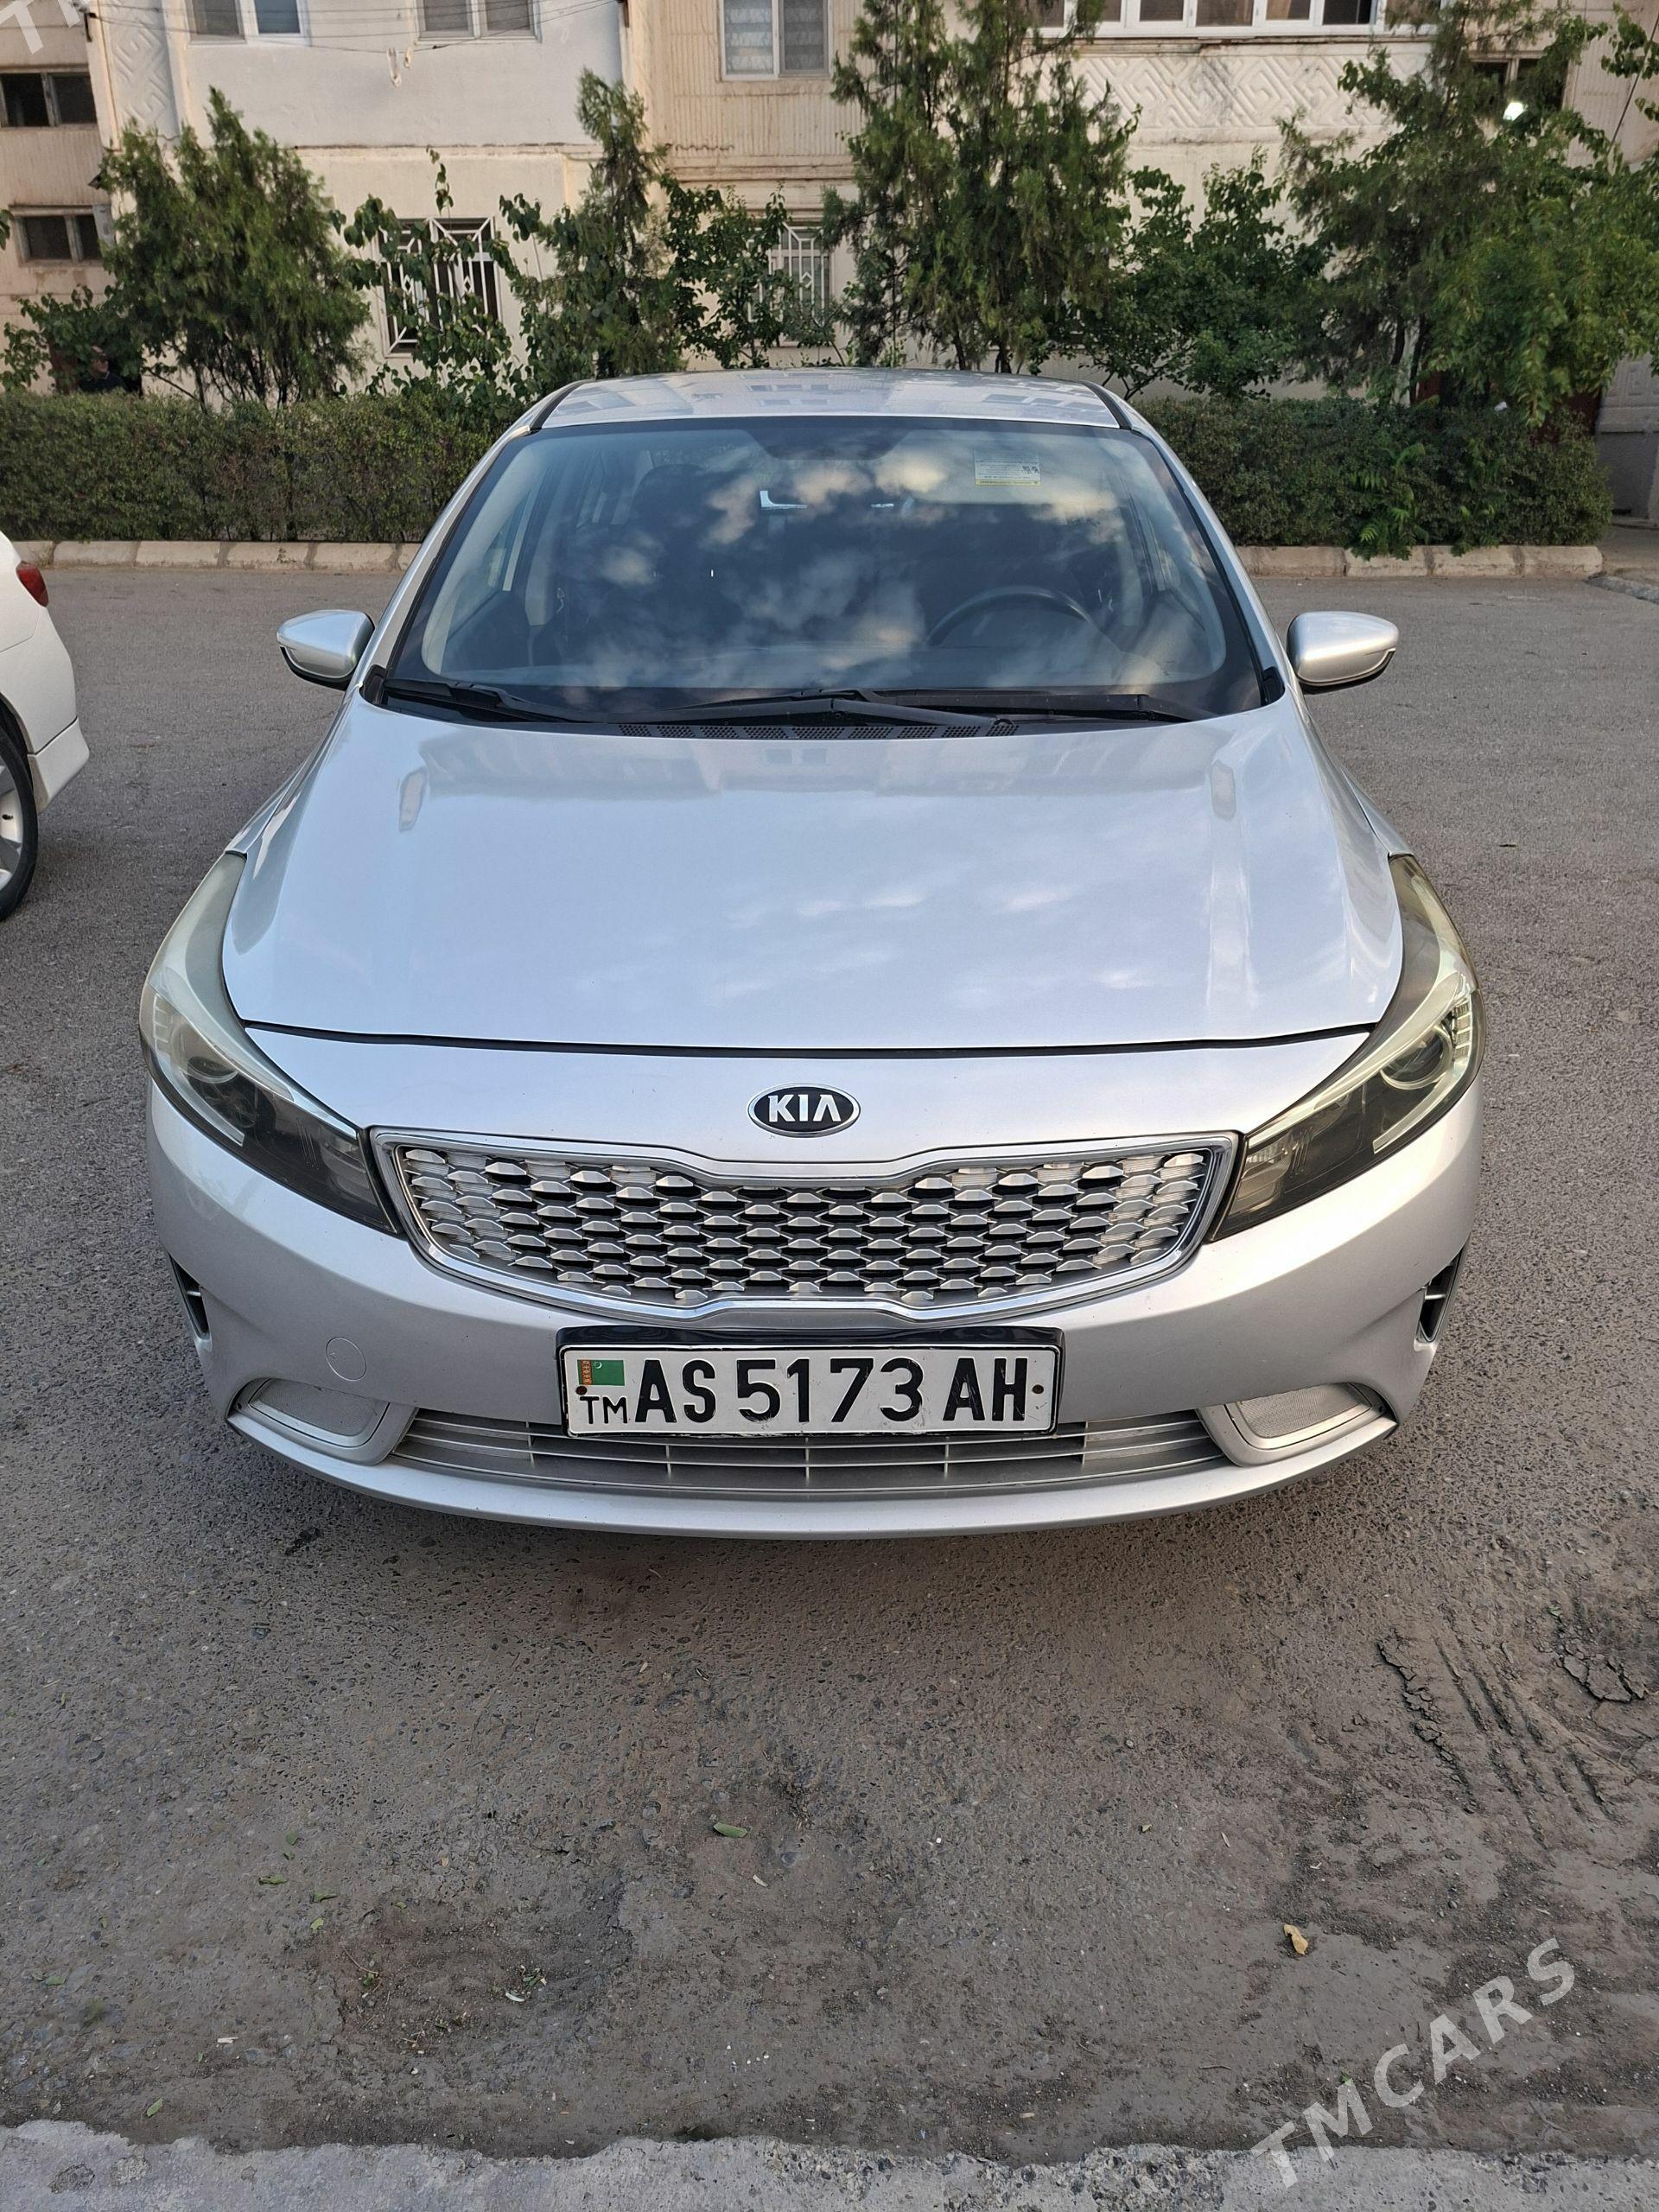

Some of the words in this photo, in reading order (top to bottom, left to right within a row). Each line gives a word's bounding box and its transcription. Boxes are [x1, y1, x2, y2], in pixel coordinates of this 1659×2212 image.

[767, 1094, 842, 1122] KIA
[634, 1359, 716, 1423] AS
[736, 1357, 925, 1423] 5173
[943, 1357, 1027, 1421] AH
[580, 1395, 628, 1424] TM
